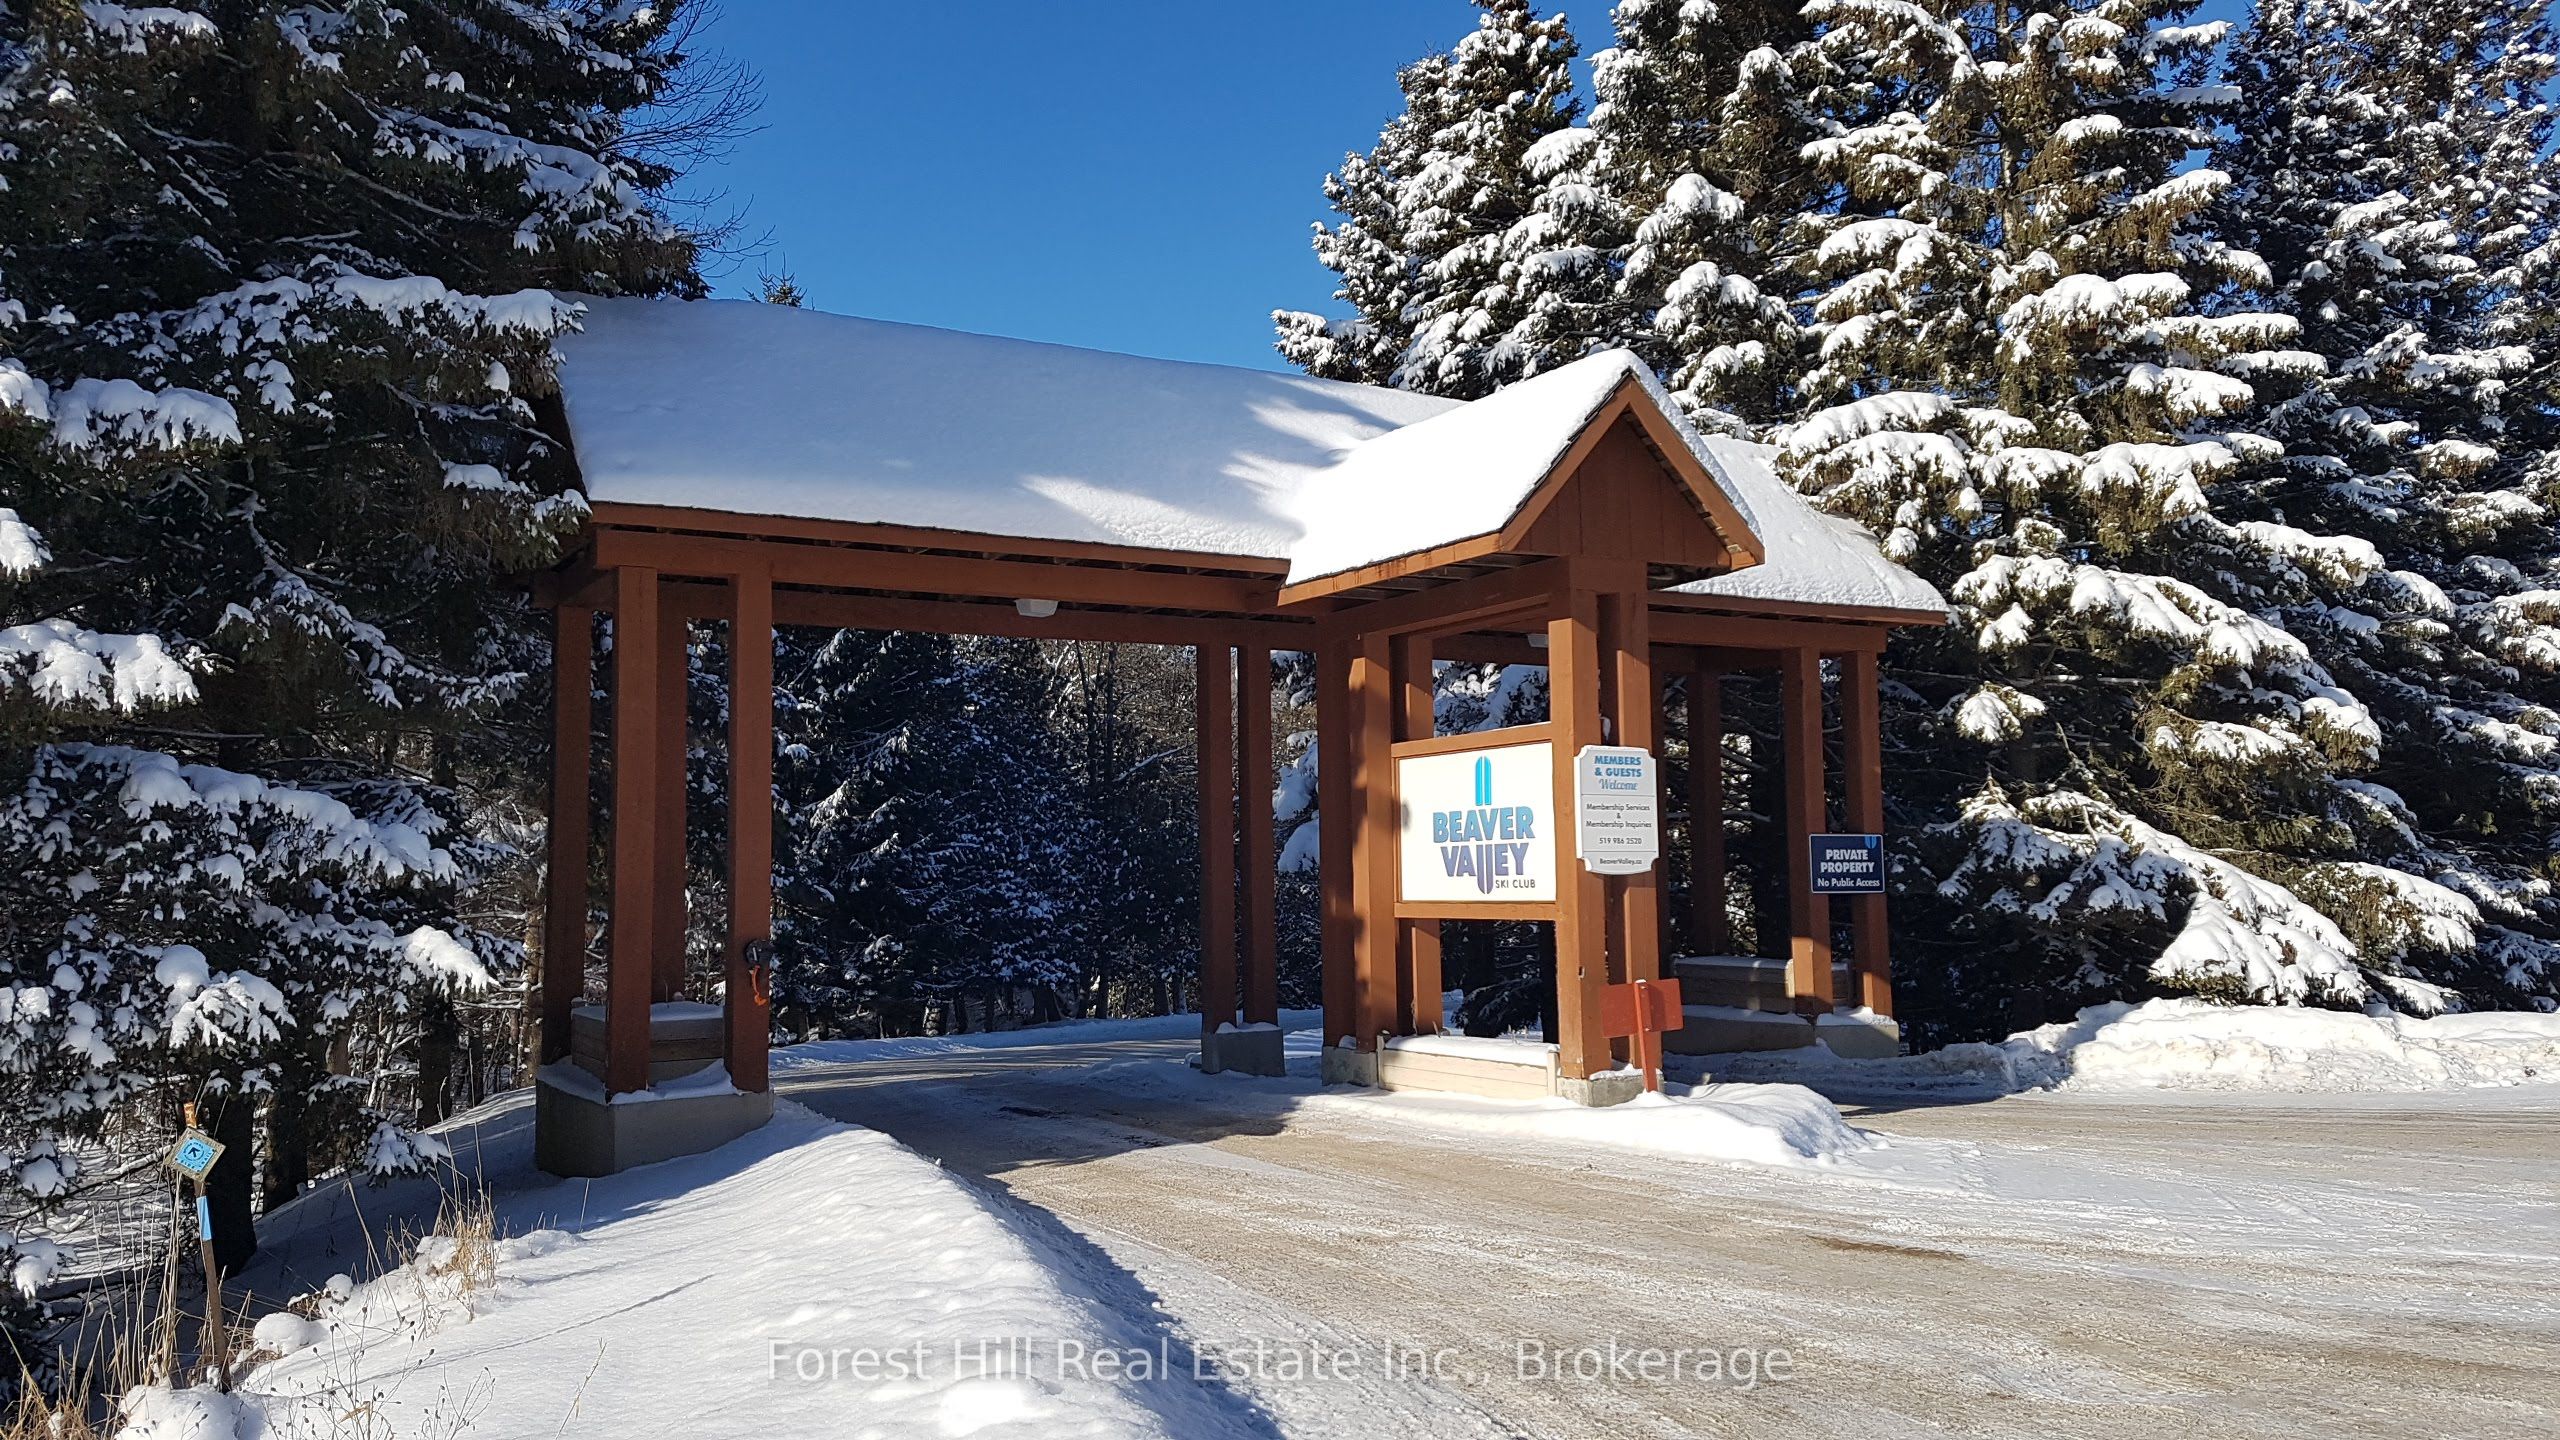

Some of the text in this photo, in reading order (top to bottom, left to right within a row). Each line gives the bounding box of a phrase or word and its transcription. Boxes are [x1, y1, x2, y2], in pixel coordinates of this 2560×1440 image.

[1594, 755, 1642, 766] MEMBERS
[1594, 767, 1642, 778] & GUESTS
[1599, 779, 1639, 791] Welcome
[1586, 803, 1651, 812] Membership Services
[1432, 805, 1536, 844] BEAVER
[1585, 820, 1653, 829] Membership Inquiries
[1599, 837, 1611, 845] 519
[1825, 849, 1869, 860] PRIVATE
[1440, 842, 1530, 895] VALLEY
[1820, 861, 1876, 873] PROPERTY
[1495, 879, 1536, 889] SKI CLUB
[1817, 877, 1881, 887] No Public Access
